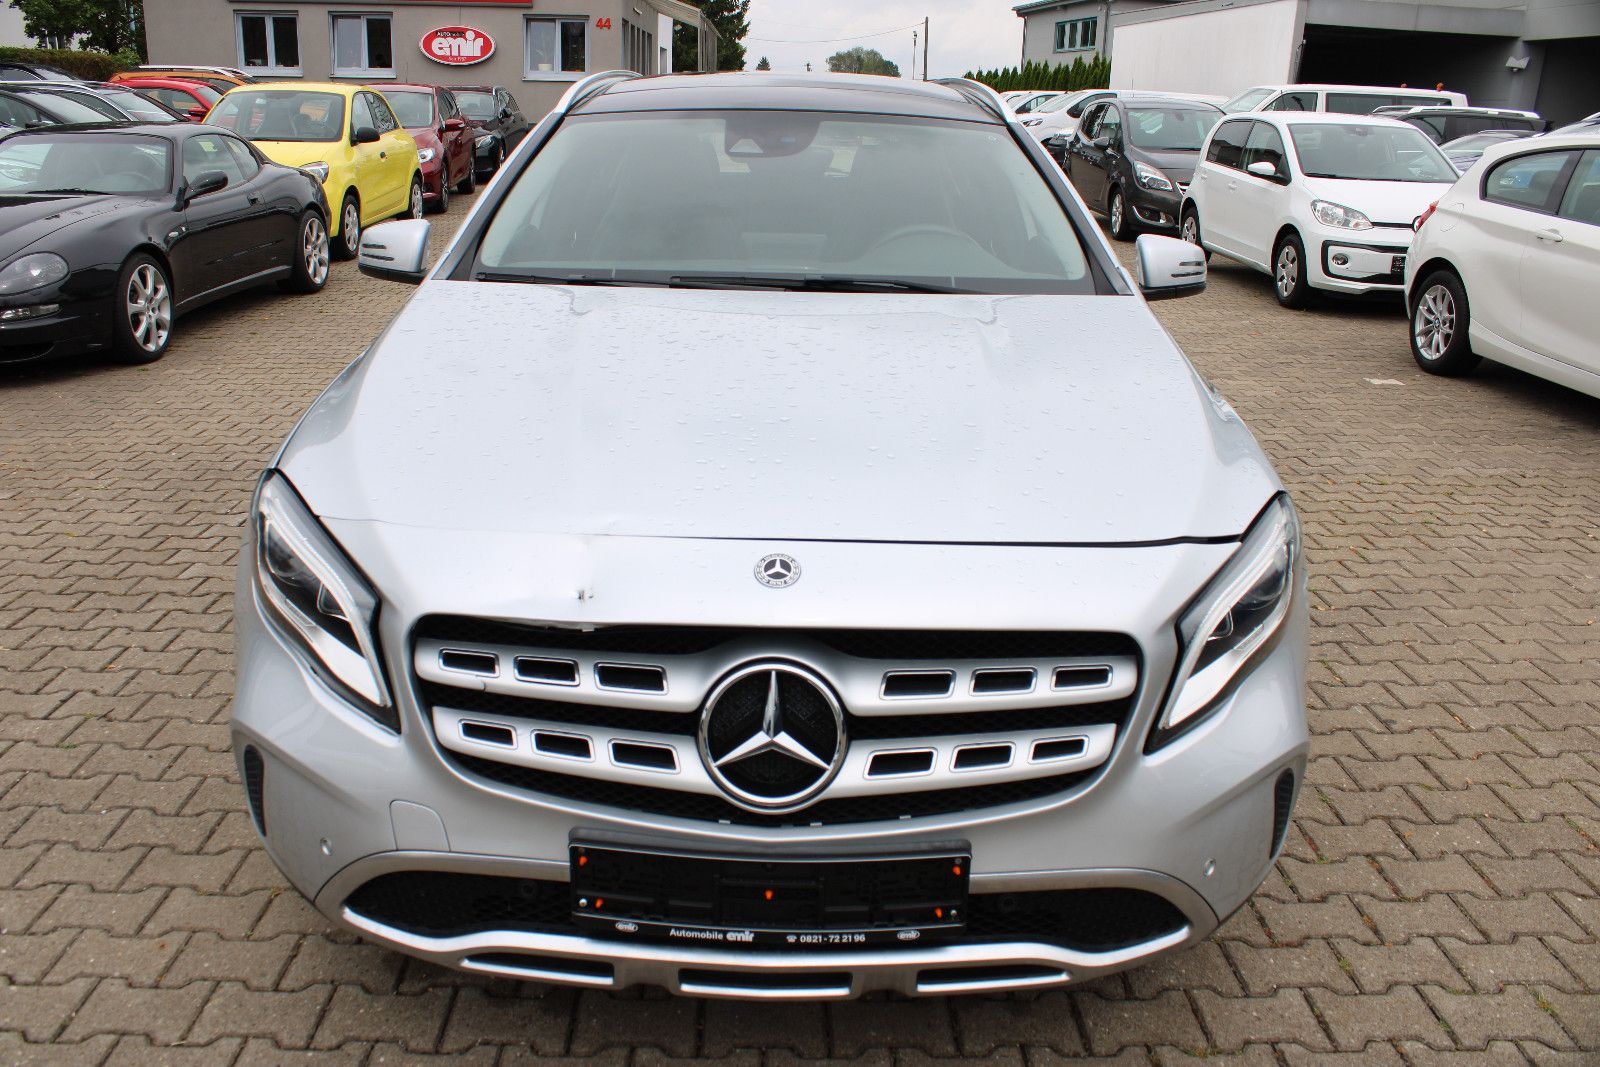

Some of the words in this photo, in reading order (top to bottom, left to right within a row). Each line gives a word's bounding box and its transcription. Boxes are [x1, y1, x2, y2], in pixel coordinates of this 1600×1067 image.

[596, 17, 611, 29] 44
[431, 30, 484, 56] emir
[669, 928, 724, 940] Automobile
[726, 931, 754, 941] emir
[842, 935, 852, 943] 21
[854, 934, 866, 942] 96
